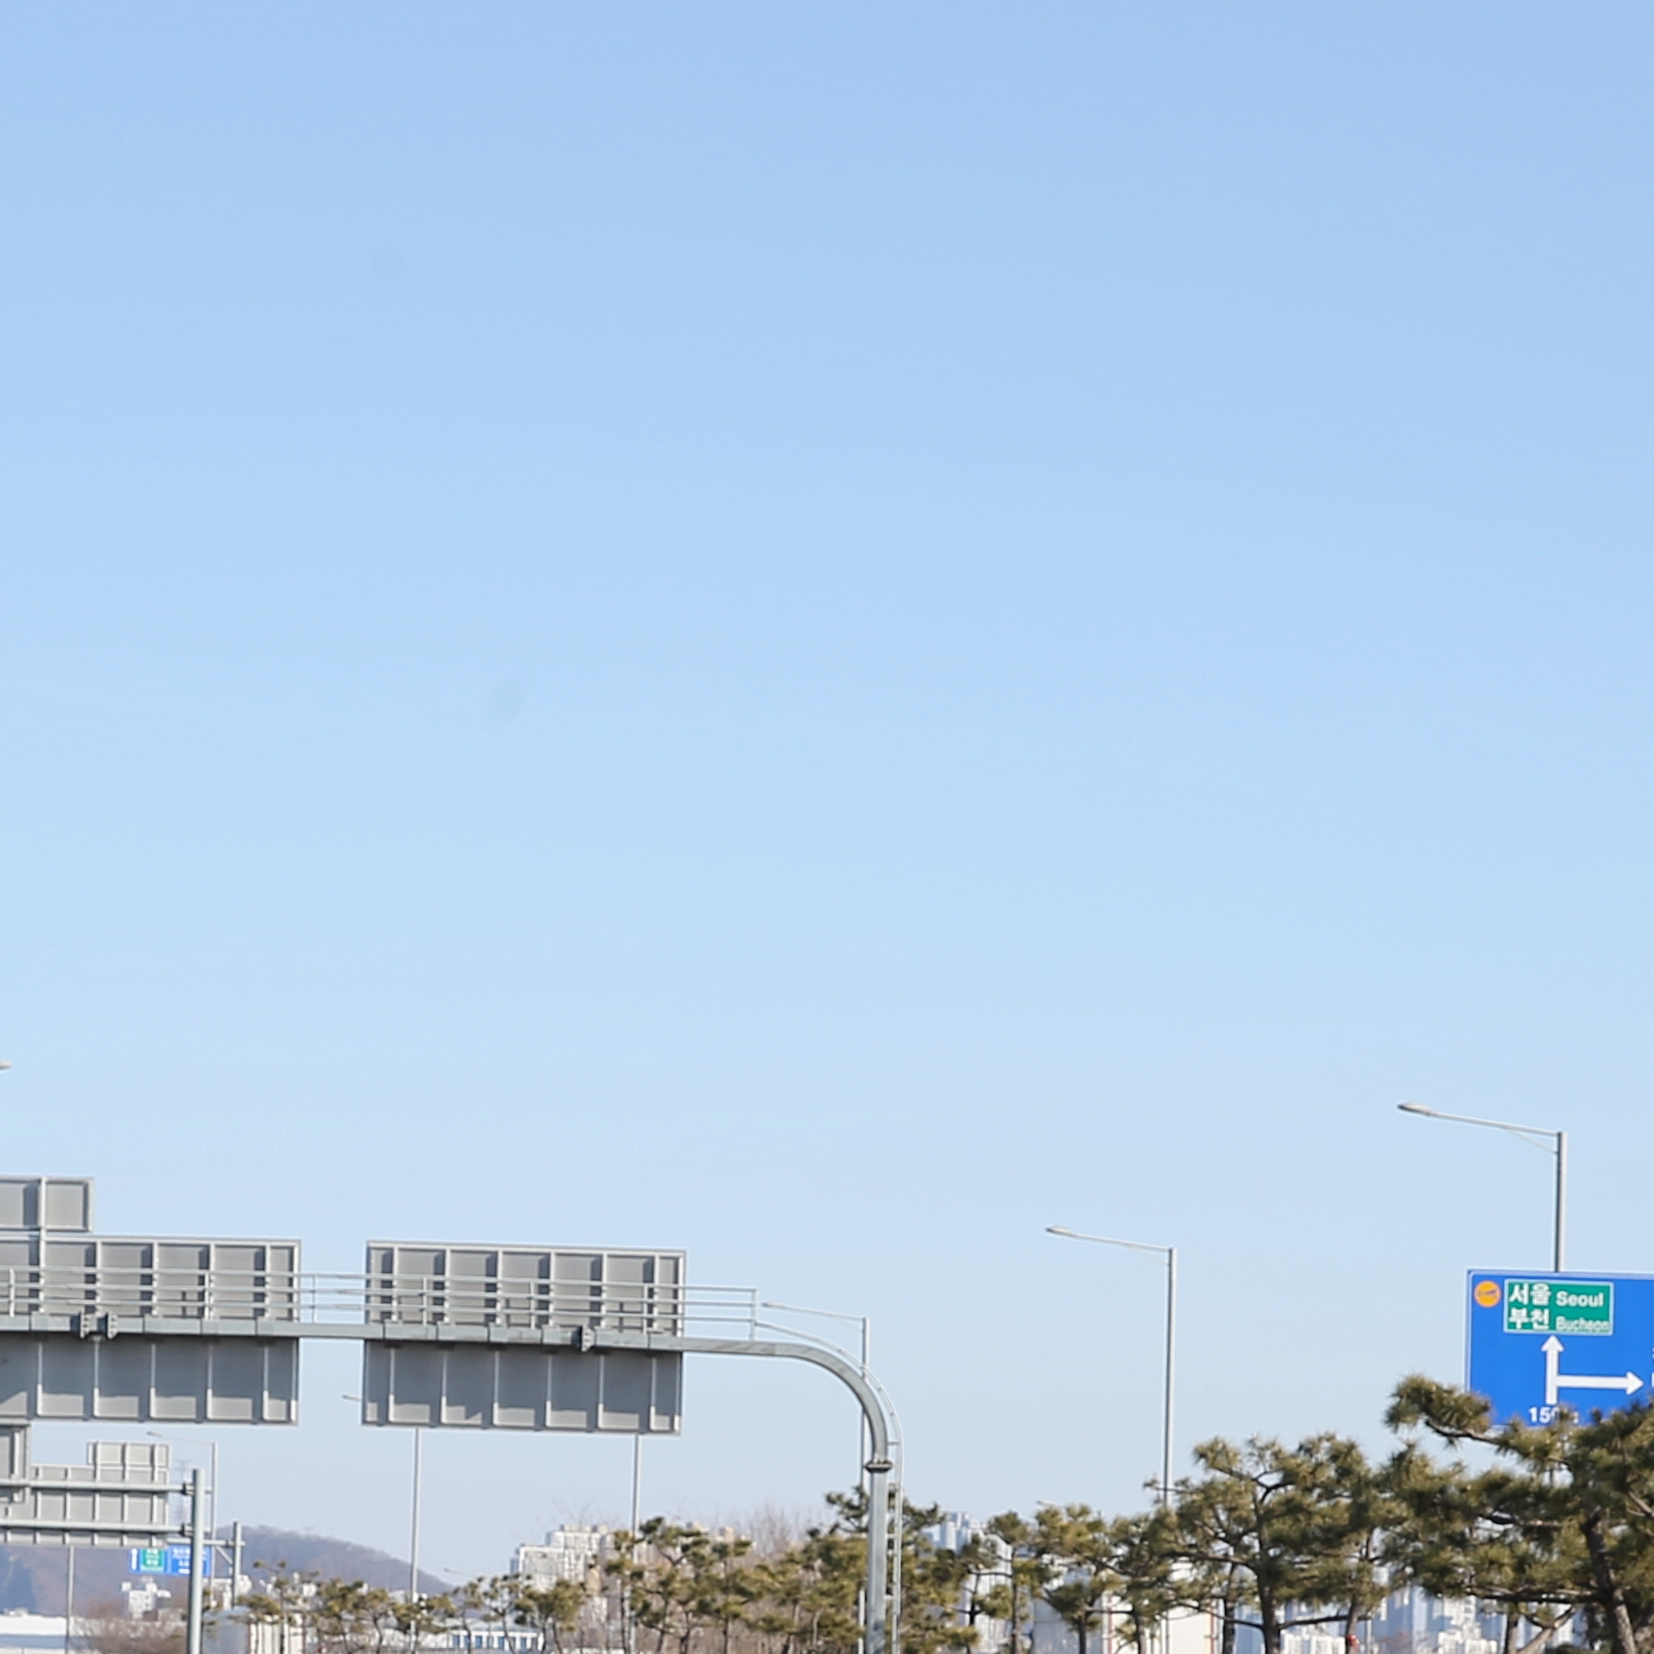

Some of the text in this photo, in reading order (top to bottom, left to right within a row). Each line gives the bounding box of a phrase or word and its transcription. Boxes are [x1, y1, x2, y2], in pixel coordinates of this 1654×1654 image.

[1509, 1282, 1604, 1307] 서울 Seoul
[1508, 1308, 1611, 1333] 부천 Bucheon
